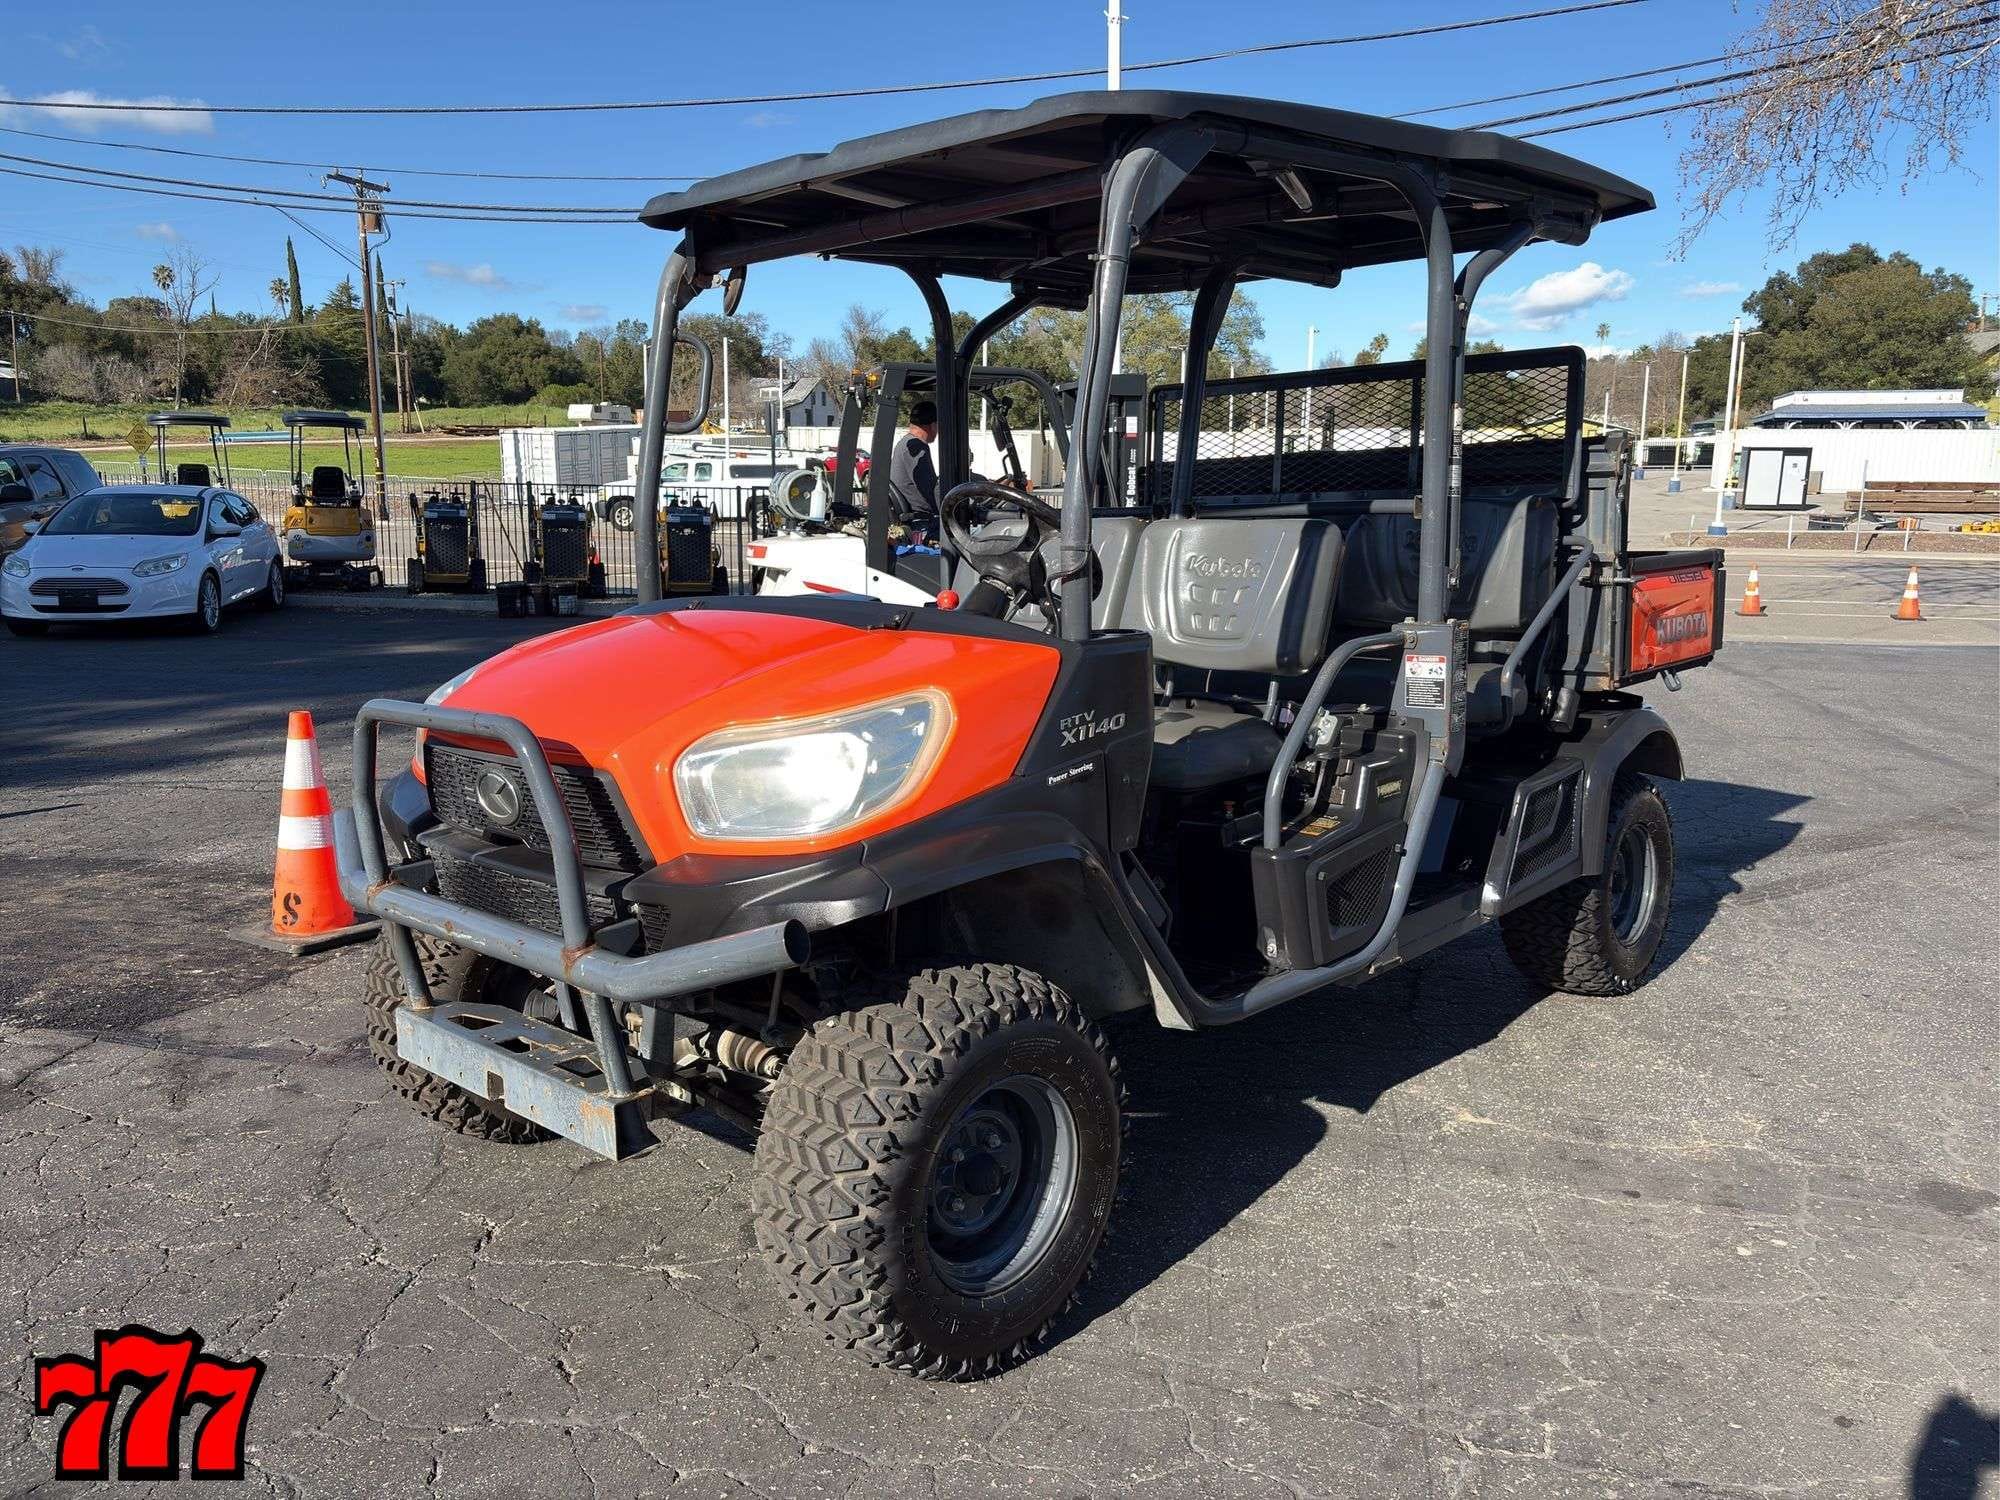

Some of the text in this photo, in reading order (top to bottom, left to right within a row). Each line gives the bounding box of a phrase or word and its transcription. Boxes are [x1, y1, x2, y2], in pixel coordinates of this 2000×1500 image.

[1668, 571, 1709, 584] DIESEL
[1656, 611, 1708, 643] KUBOTA
[1060, 710, 1095, 730] RTV
[1060, 713, 1126, 747] X1140
[1048, 772, 1068, 785] Power
[282, 892, 302, 926] S
